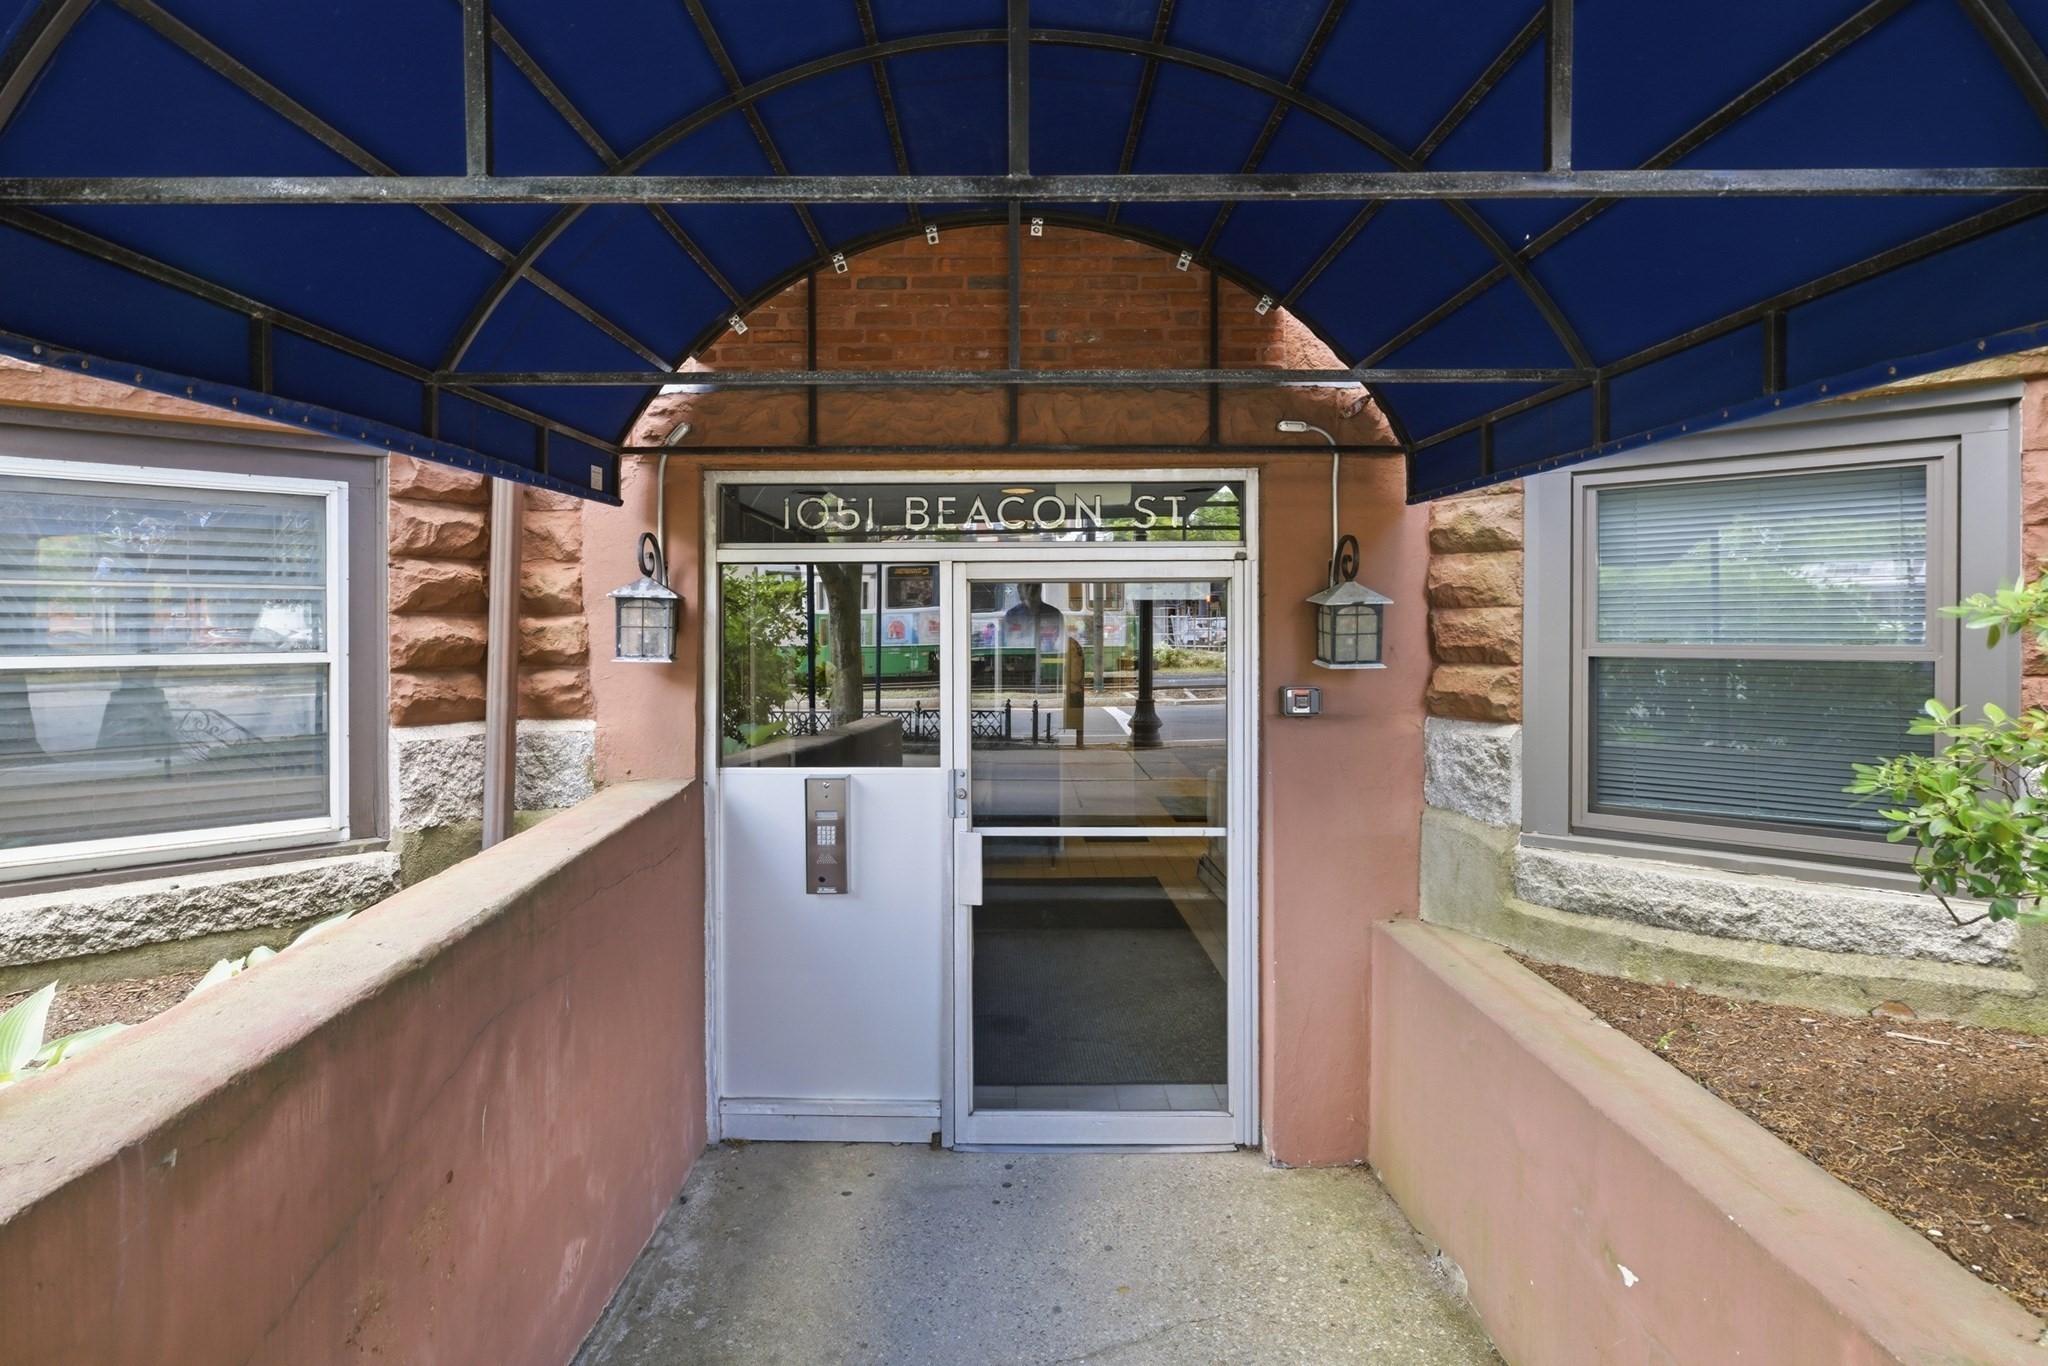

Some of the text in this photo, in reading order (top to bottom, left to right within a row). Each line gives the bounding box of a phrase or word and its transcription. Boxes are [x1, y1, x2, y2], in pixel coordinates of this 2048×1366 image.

[784, 494, 1187, 531] 1051 BEACON ST
